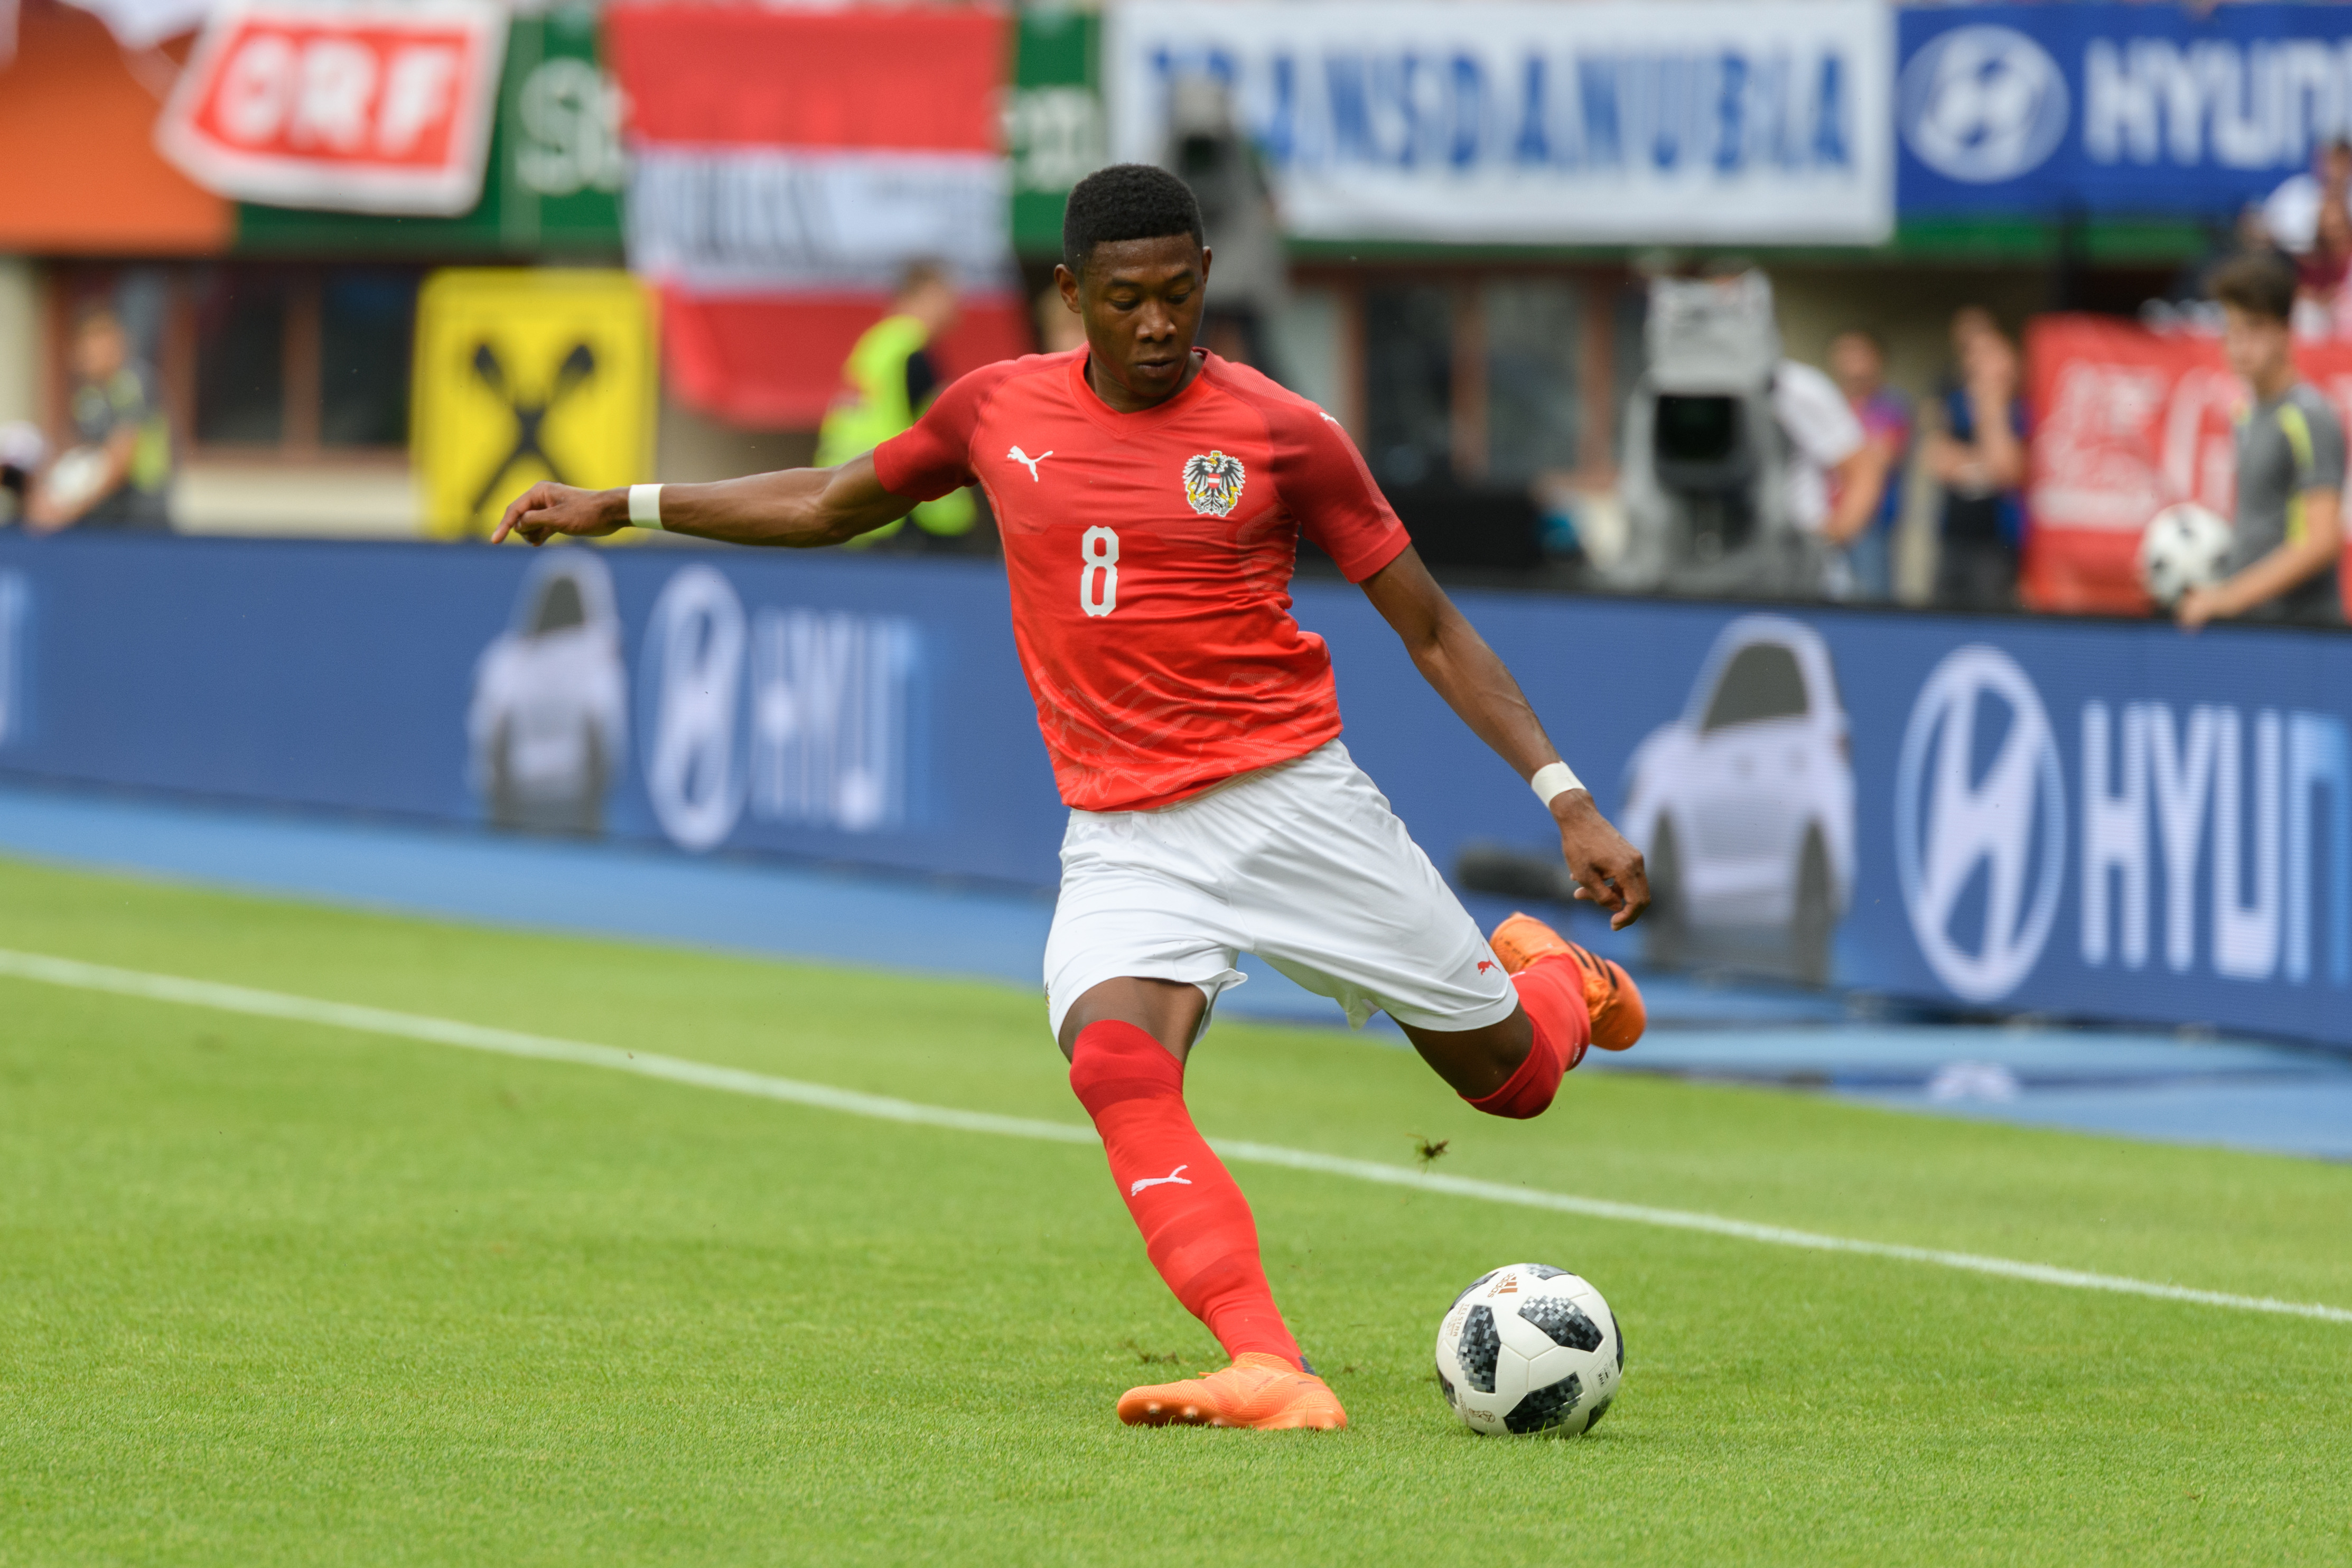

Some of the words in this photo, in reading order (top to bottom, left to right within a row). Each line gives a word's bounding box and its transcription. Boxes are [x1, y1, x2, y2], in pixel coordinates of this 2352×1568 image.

[214, 34, 458, 155] ORF
[2083, 37, 2352, 169] HYUN
[1080, 525, 1119, 617] 8
[1452, 1303, 1470, 1337] TELSTRA
[1487, 1273, 1515, 1298] adidas
